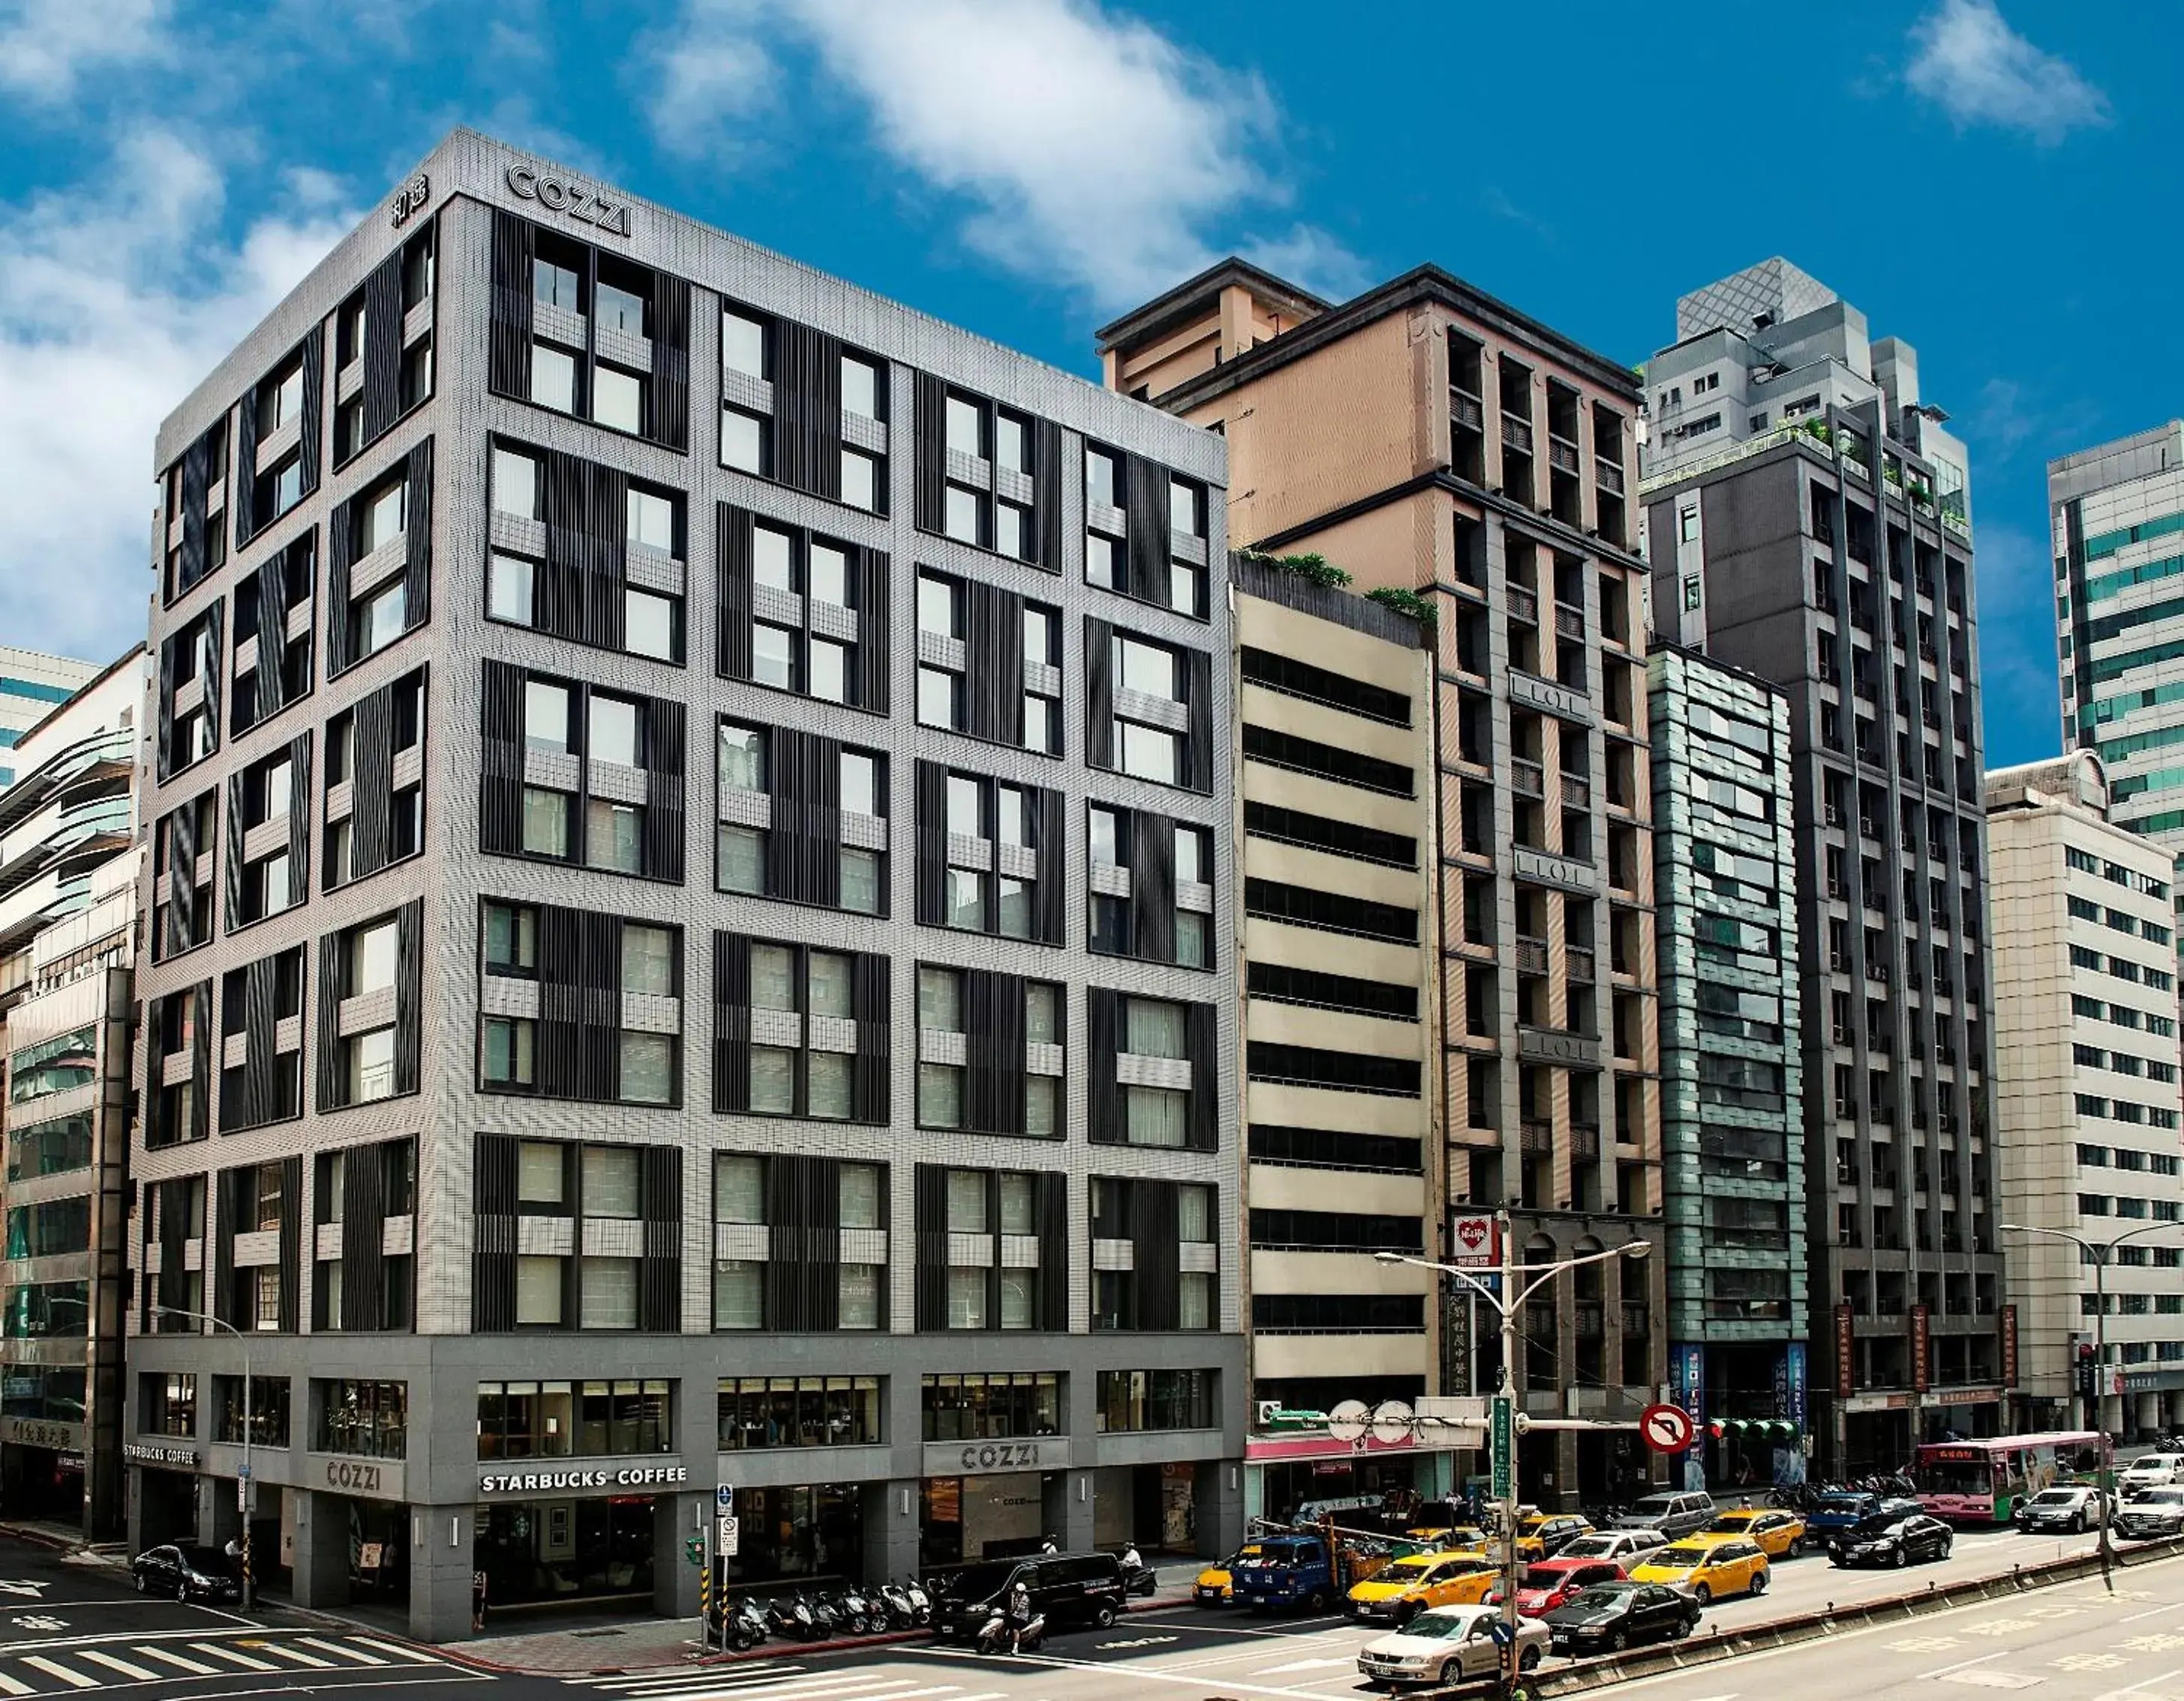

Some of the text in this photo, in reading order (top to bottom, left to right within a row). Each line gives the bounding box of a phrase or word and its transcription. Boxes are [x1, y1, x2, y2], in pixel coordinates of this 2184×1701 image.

[507, 164, 632, 237] COZZI
[125, 1444, 194, 1465] STARBUCKS COFFEE
[962, 1444, 1039, 1468] COZZI
[327, 1462, 380, 1490] COZZI
[482, 1467, 687, 1492] STARBUCKS COFFEE
